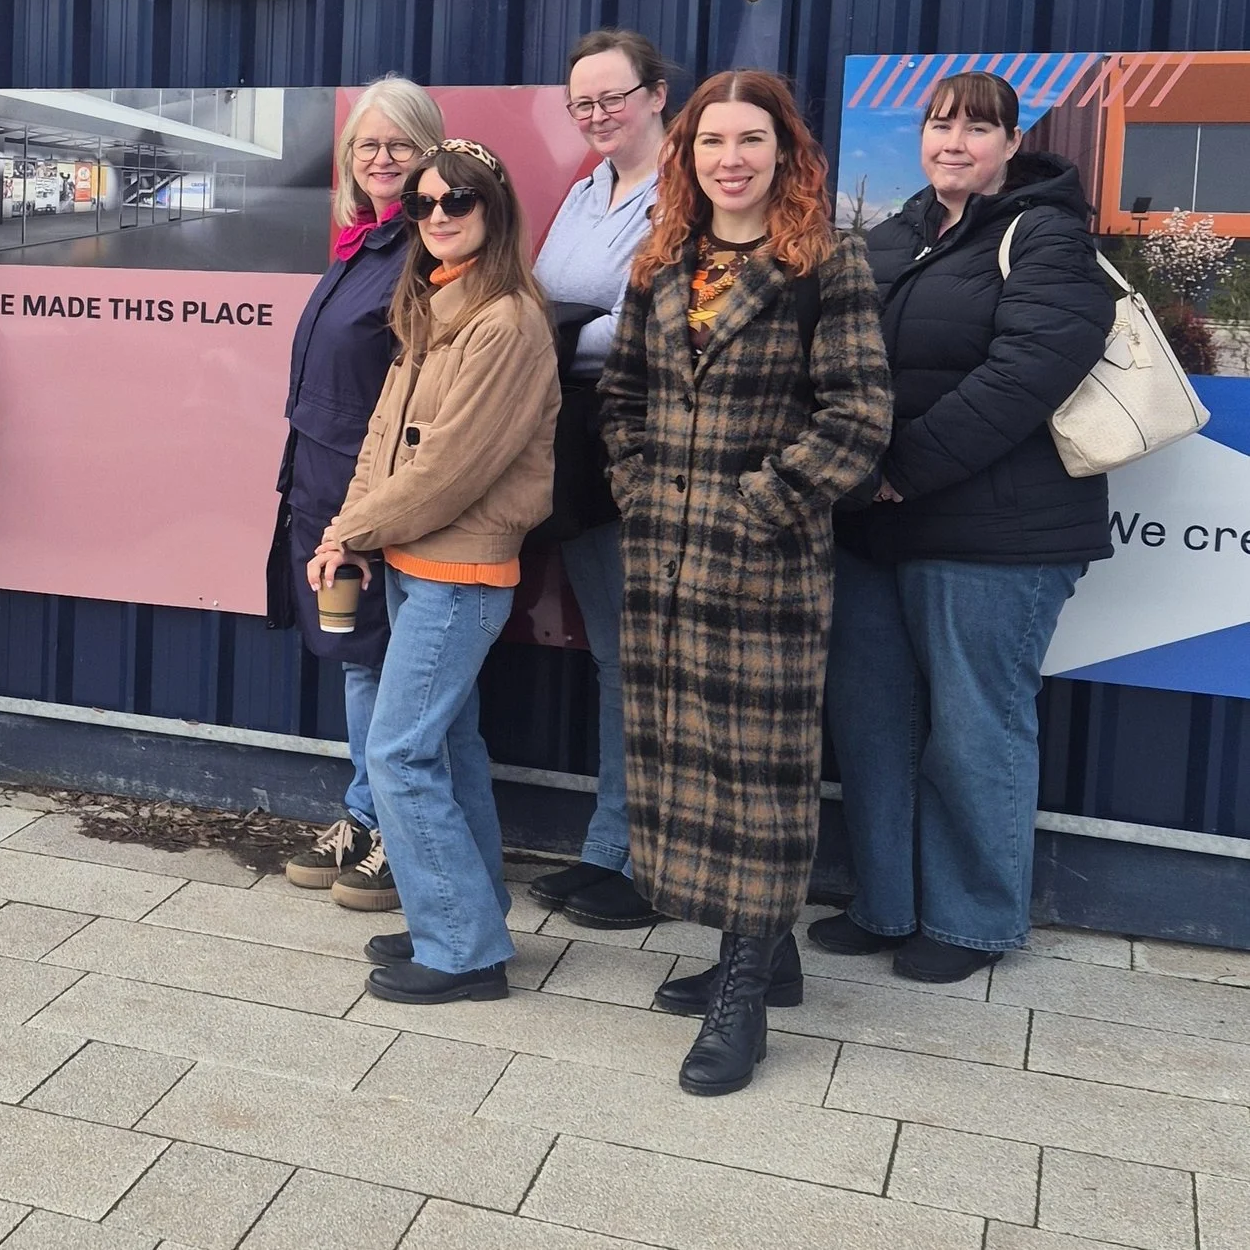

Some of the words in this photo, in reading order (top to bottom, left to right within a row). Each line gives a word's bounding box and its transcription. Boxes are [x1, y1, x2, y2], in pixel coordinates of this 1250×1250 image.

[22, 295, 101, 319] MADE
[108, 298, 174, 322] THIS
[182, 301, 273, 326] PLACE
[1109, 511, 1166, 547] We
